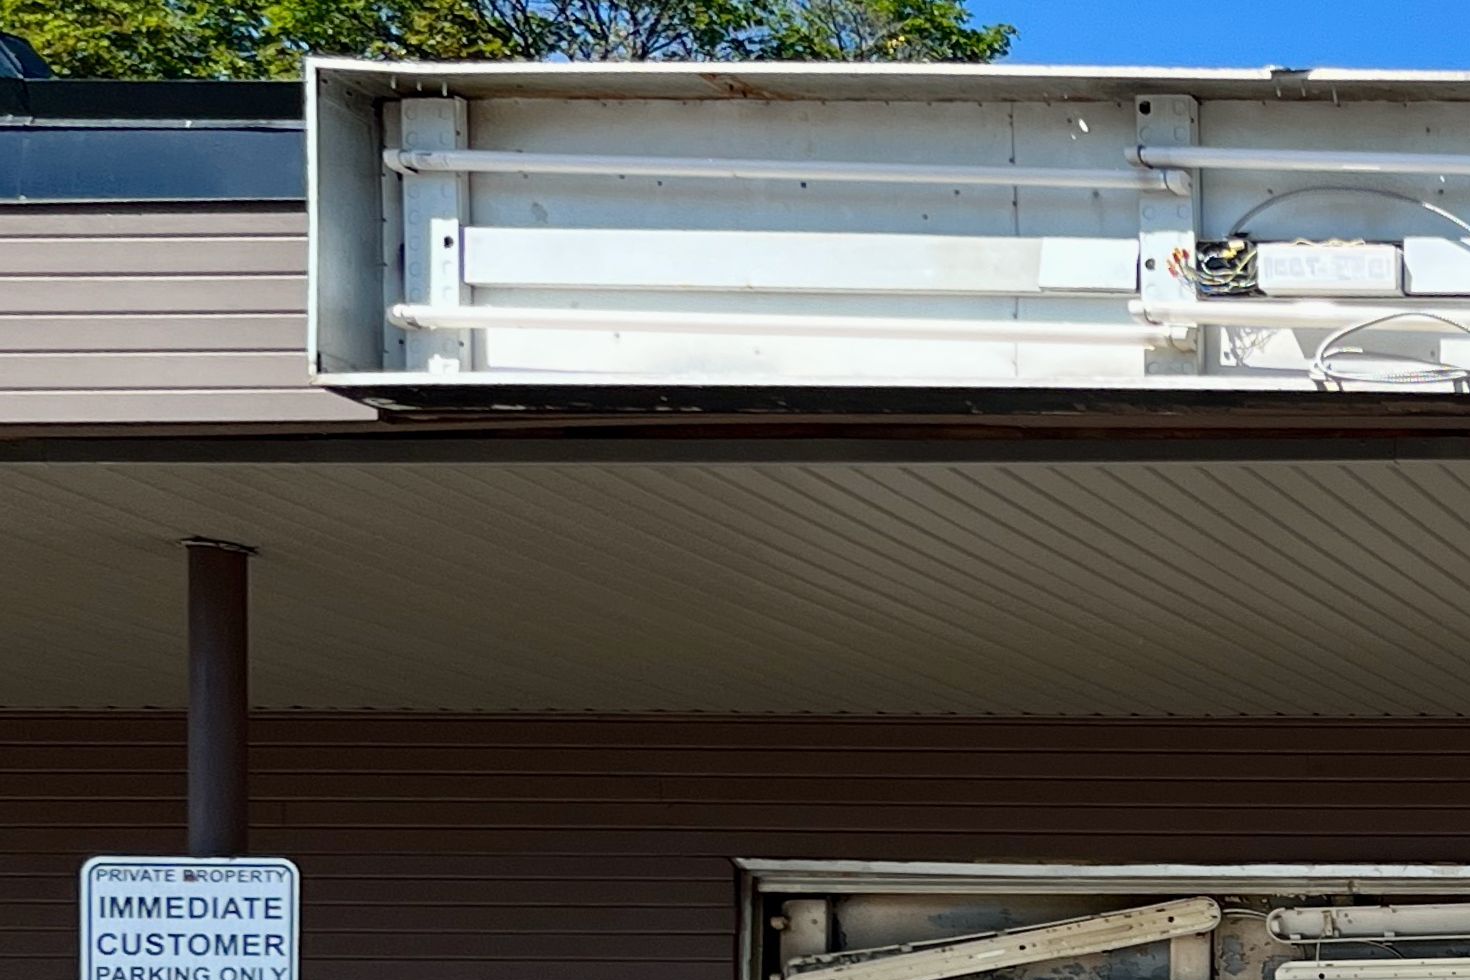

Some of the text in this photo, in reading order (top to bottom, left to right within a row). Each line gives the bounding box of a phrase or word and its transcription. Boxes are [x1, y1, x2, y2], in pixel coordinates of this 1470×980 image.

[96, 869, 287, 883] PRIVATE PROPERTY
[100, 897, 283, 920] IMMEDIATE
[96, 933, 286, 956] CUSTOMER
